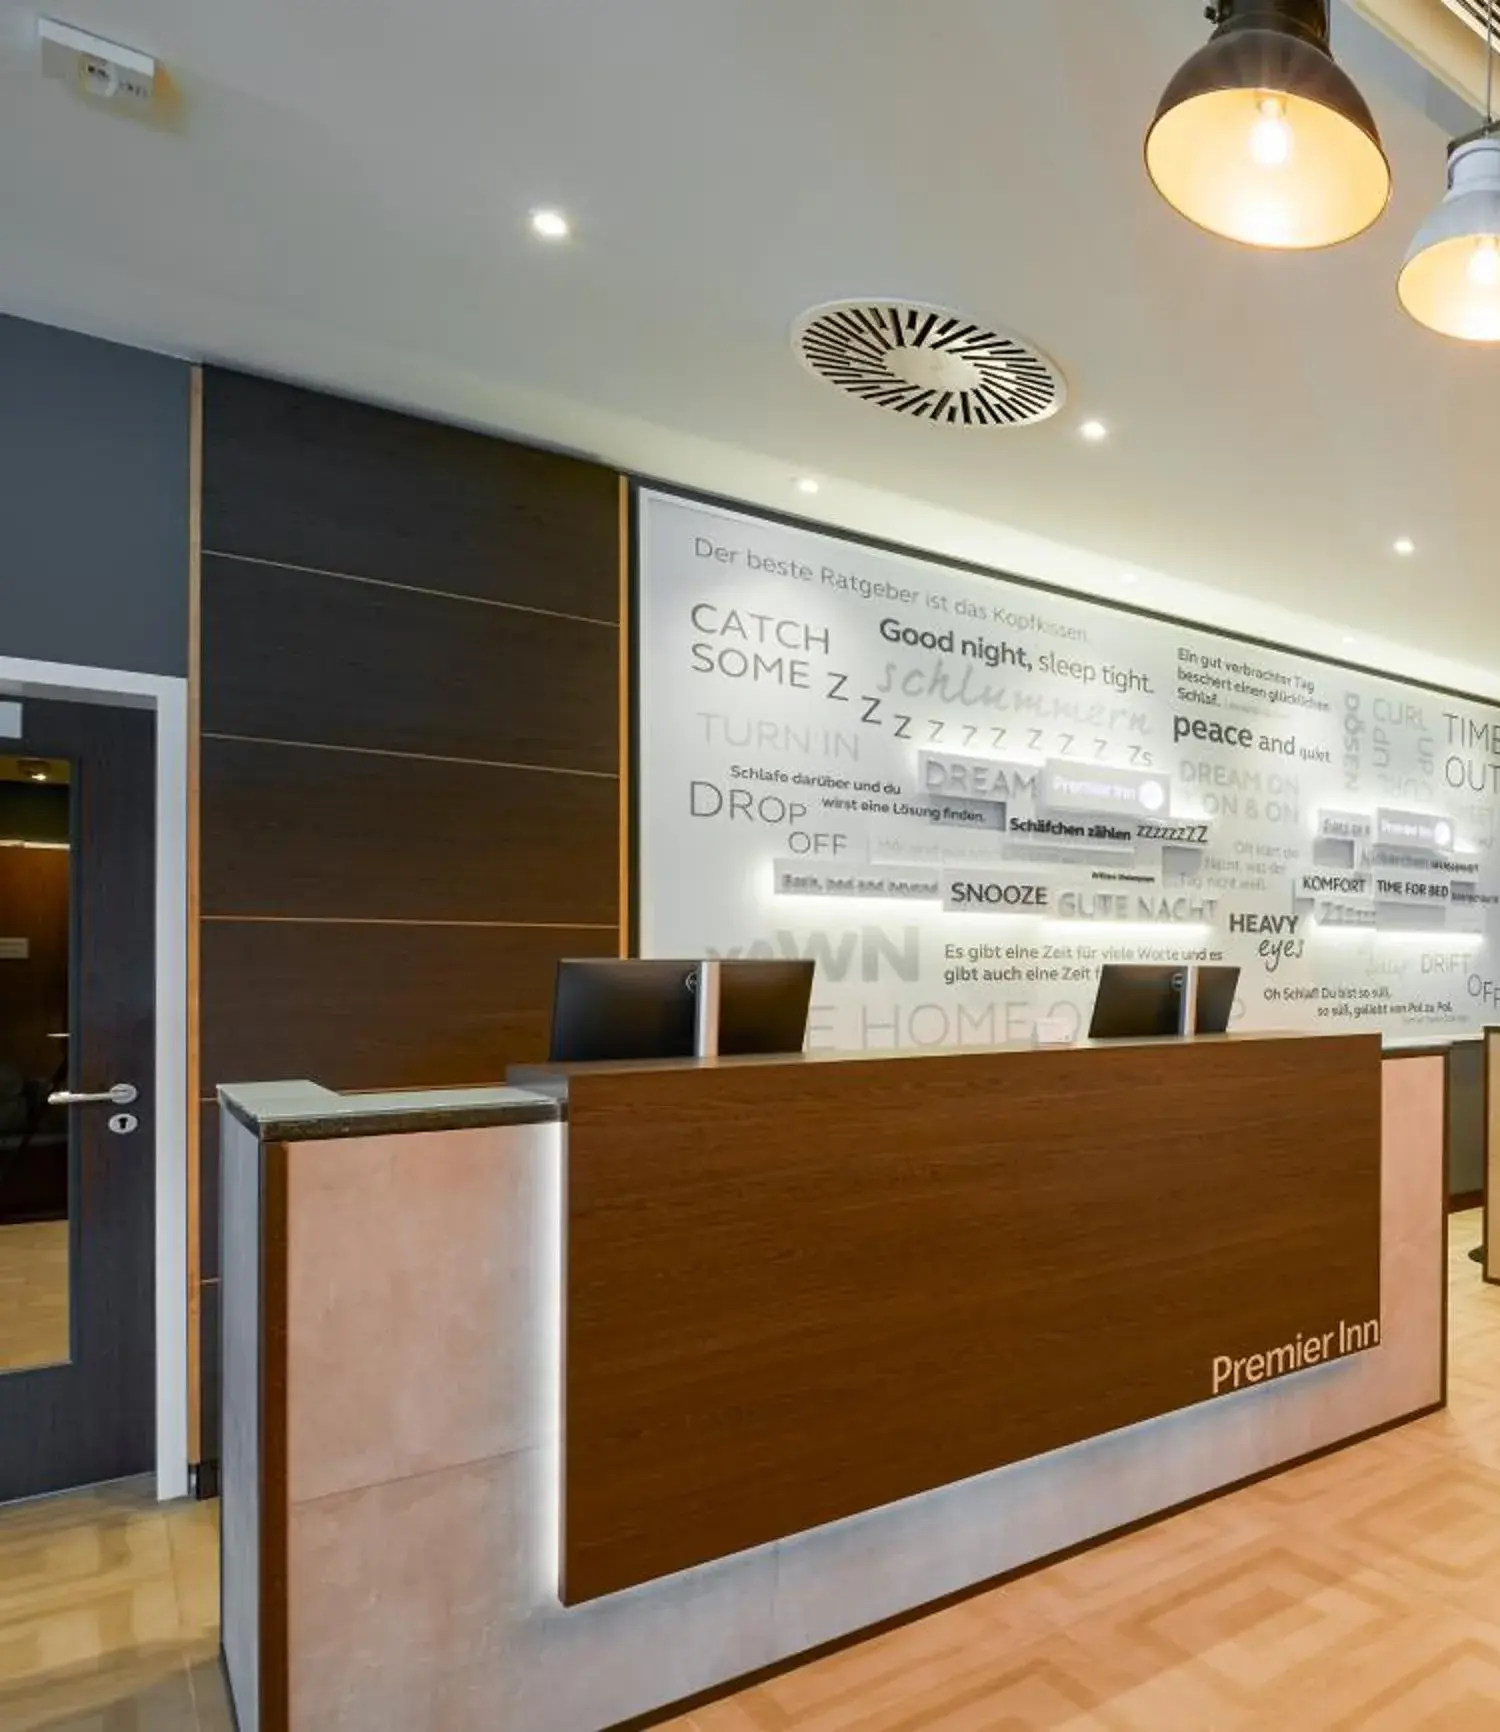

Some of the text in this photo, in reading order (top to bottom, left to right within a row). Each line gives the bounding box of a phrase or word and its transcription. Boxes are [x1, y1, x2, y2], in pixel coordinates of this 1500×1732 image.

[695, 537, 738, 564] Der
[747, 549, 813, 582] beste
[821, 566, 919, 604] Ratgeber
[925, 592, 949, 613] ist
[957, 600, 987, 620] das
[691, 603, 830, 655] CATCH
[691, 642, 811, 690] SOME
[879, 618, 1155, 695] Good night, sleep tight.
[1176, 647, 1198, 664] Ein
[1201, 655, 1223, 670] gut
[1295, 676, 1316, 695] Tag
[1177, 666, 1233, 692] beschert
[1234, 681, 1267, 700] einen
[1372, 697, 1429, 733] CURL
[696, 711, 861, 763] TURN IN
[1173, 714, 1332, 763] peace and quiet
[730, 765, 902, 796] Schlafe darüber und du
[926, 759, 1039, 803] DREAM
[1179, 759, 1262, 792] DREAM
[689, 780, 808, 826] DROP
[821, 796, 984, 824] wirst eine Lösung finden.
[788, 831, 848, 857] OFF
[1009, 817, 1085, 839] Schäfchen
[1086, 824, 1132, 842] zählen
[950, 882, 1048, 905] SNOOZE
[1302, 875, 1367, 893] KOMFORT
[1376, 879, 1403, 896] TIME
[1405, 882, 1427, 897] FOR
[1428, 885, 1450, 899] BED
[1229, 913, 1300, 935] HEAVY
[944, 943, 1223, 964] Es gibt eine Zeit für viele Worte und es
[1257, 938, 1305, 973] eyes
[1420, 952, 1472, 975] DRIFT
[943, 966, 979, 986] gibt
[982, 967, 1022, 983] auch
[1026, 968, 1059, 983] eine
[1062, 967, 1091, 983] Zeit
[1263, 987, 1281, 1001] Oh
[861, 1002, 1029, 1051] HOME
[1212, 1318, 1379, 1394] Premier Inn
